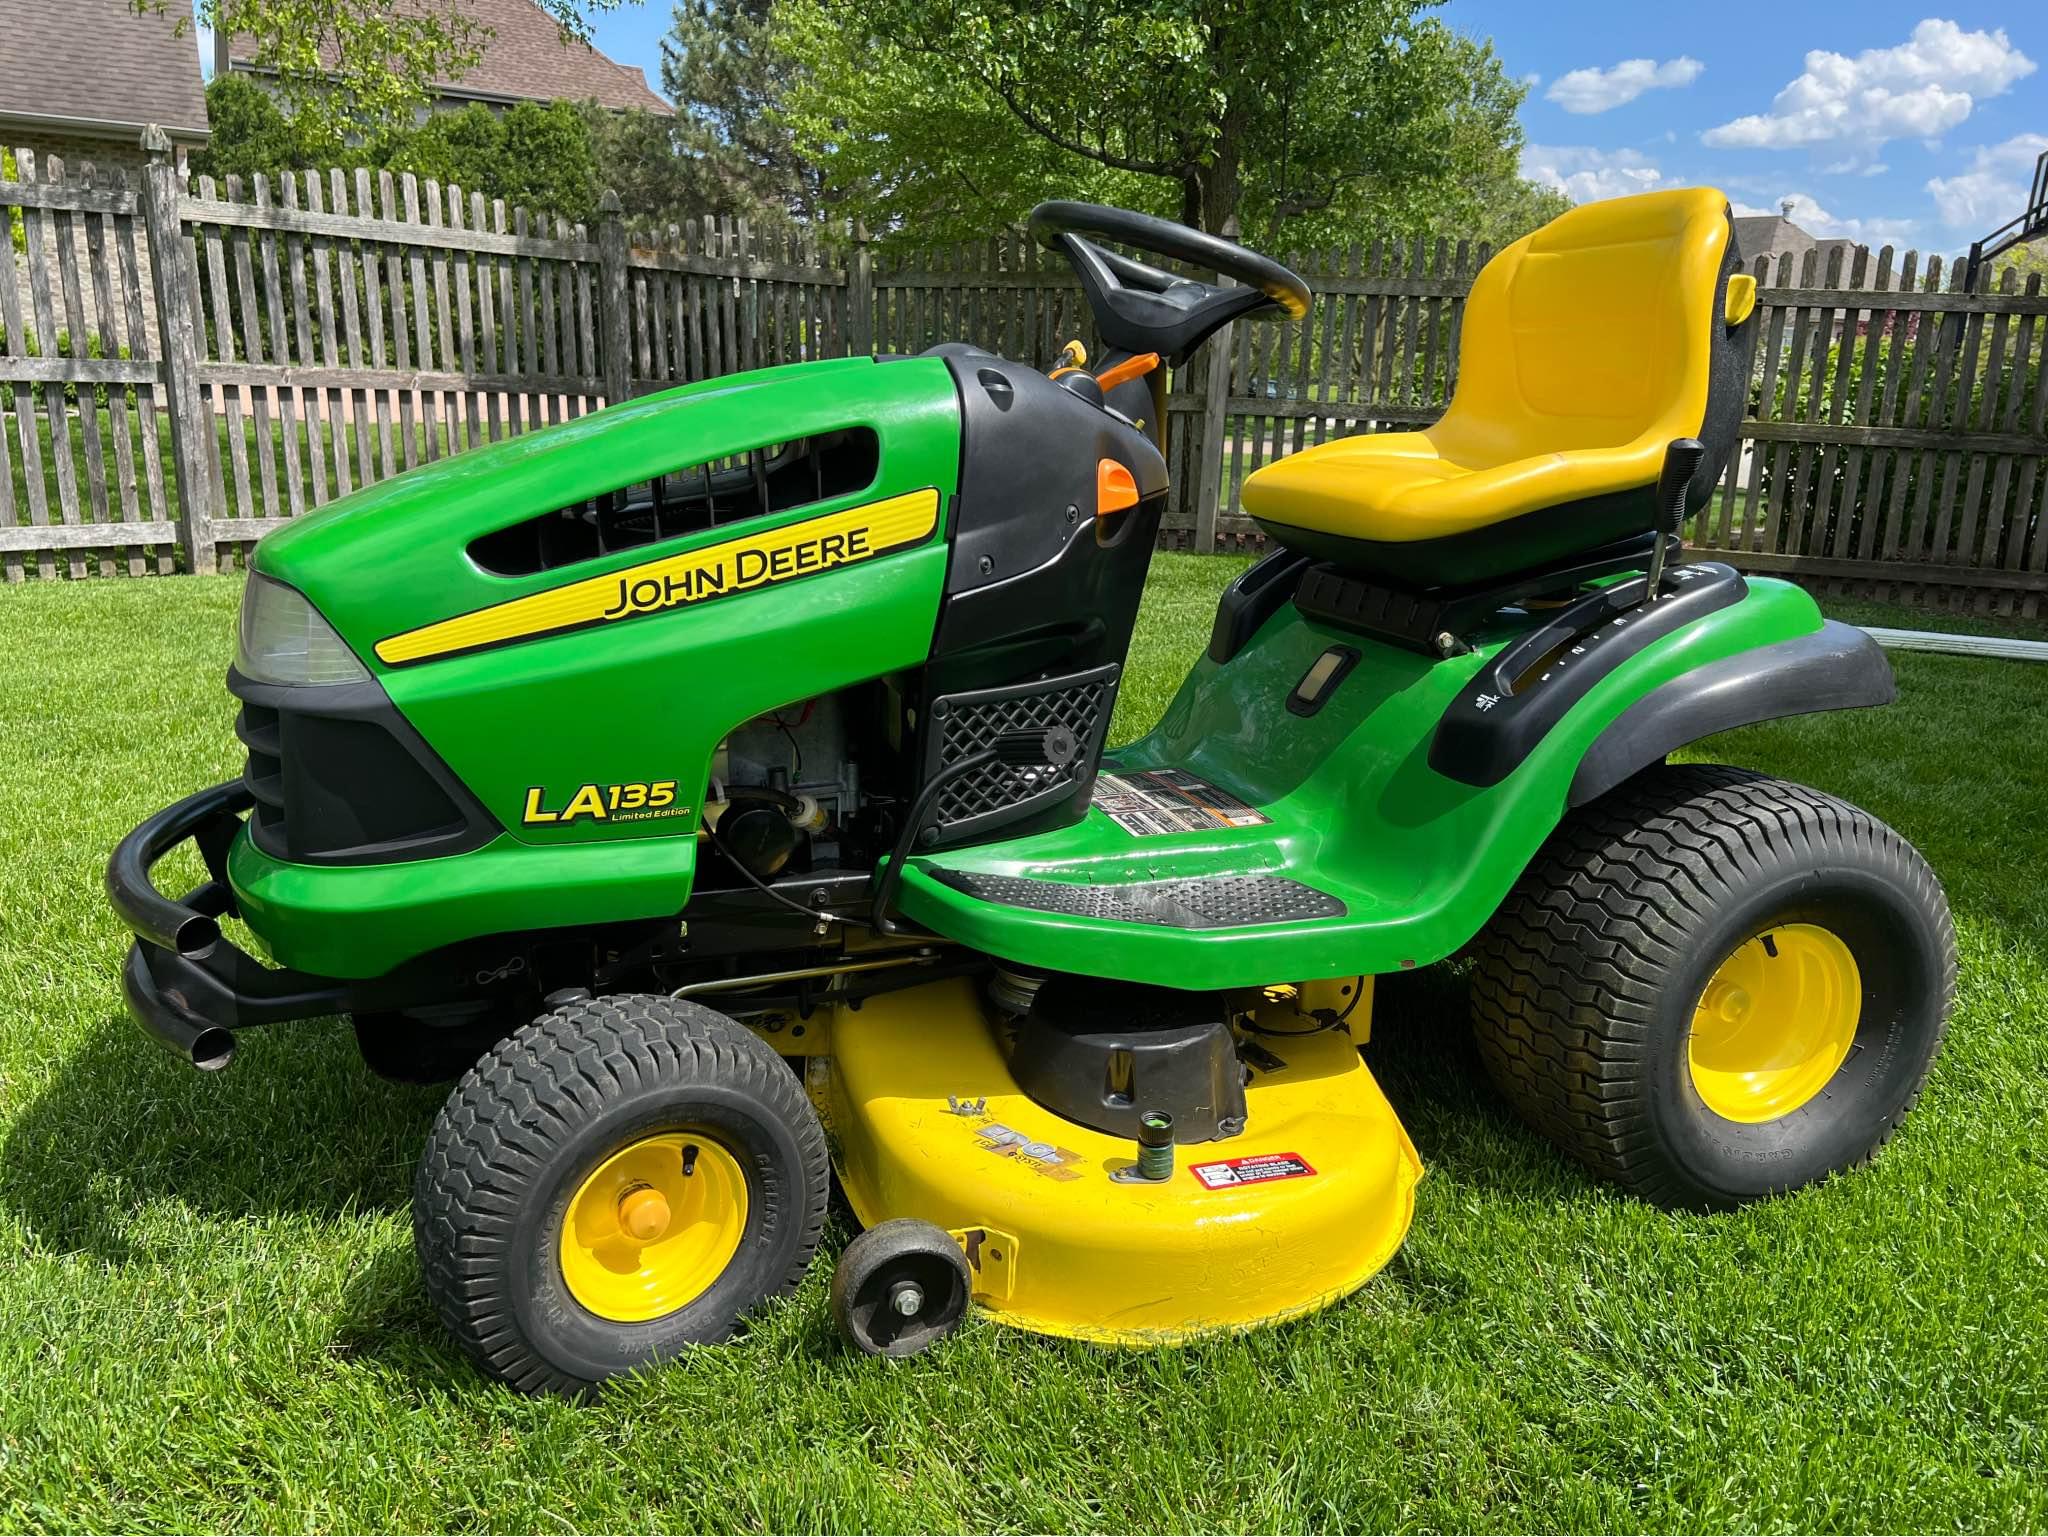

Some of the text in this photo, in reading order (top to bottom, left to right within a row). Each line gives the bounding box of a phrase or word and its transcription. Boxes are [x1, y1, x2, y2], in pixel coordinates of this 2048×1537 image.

[603, 526, 871, 617] JOHN DEERE
[611, 807, 690, 822] Limited Edition
